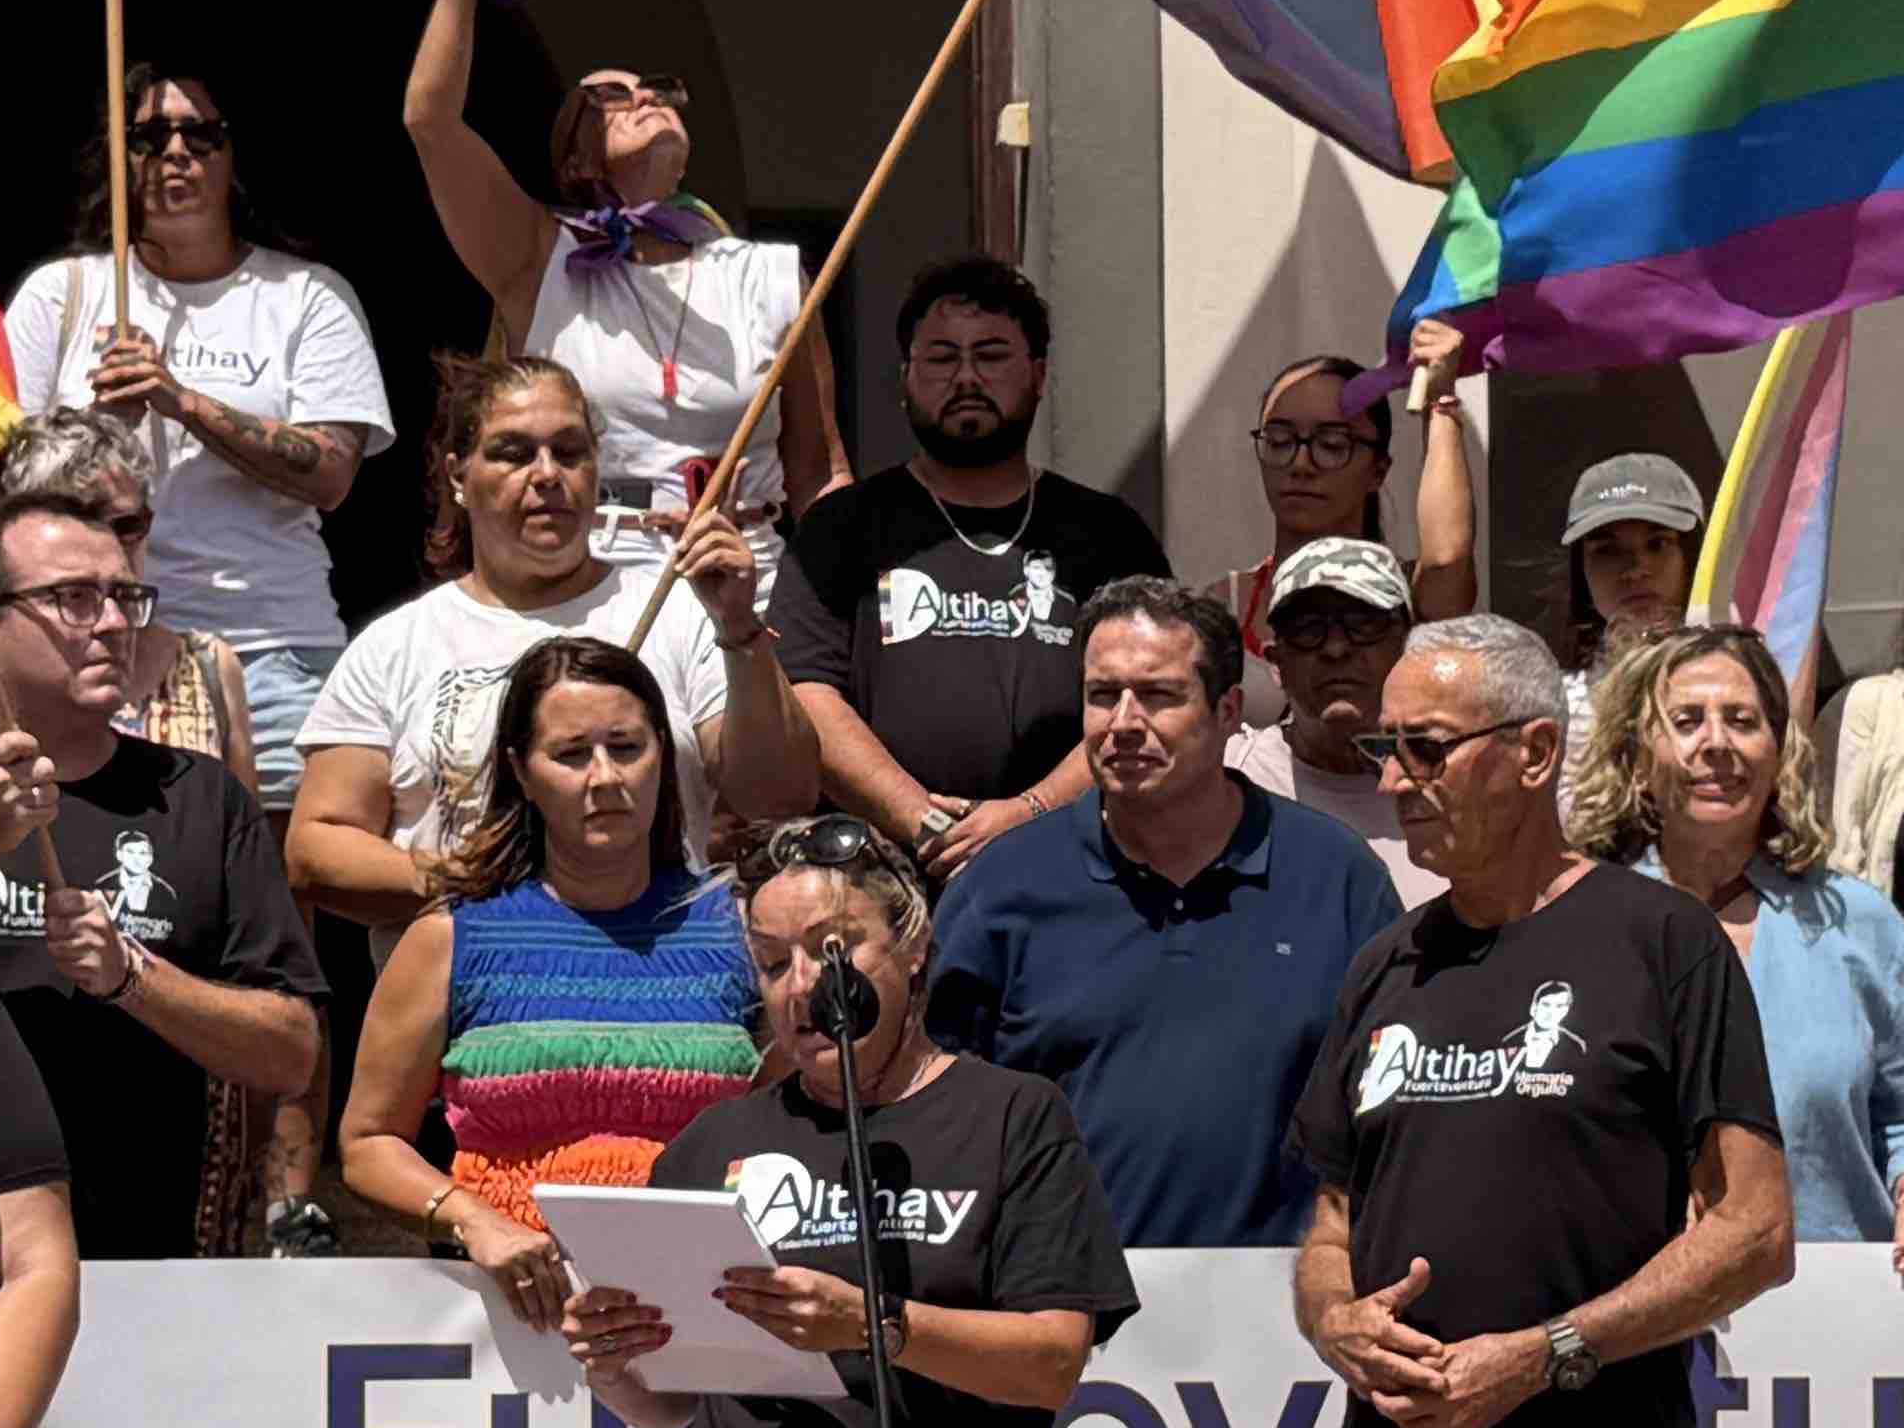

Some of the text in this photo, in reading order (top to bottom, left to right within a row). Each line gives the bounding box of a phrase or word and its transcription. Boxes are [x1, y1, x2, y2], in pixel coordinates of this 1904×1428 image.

[908, 584, 1033, 639] Altihay
[1378, 1039, 1527, 1098] Altihay
[758, 1172, 979, 1244] Althay
